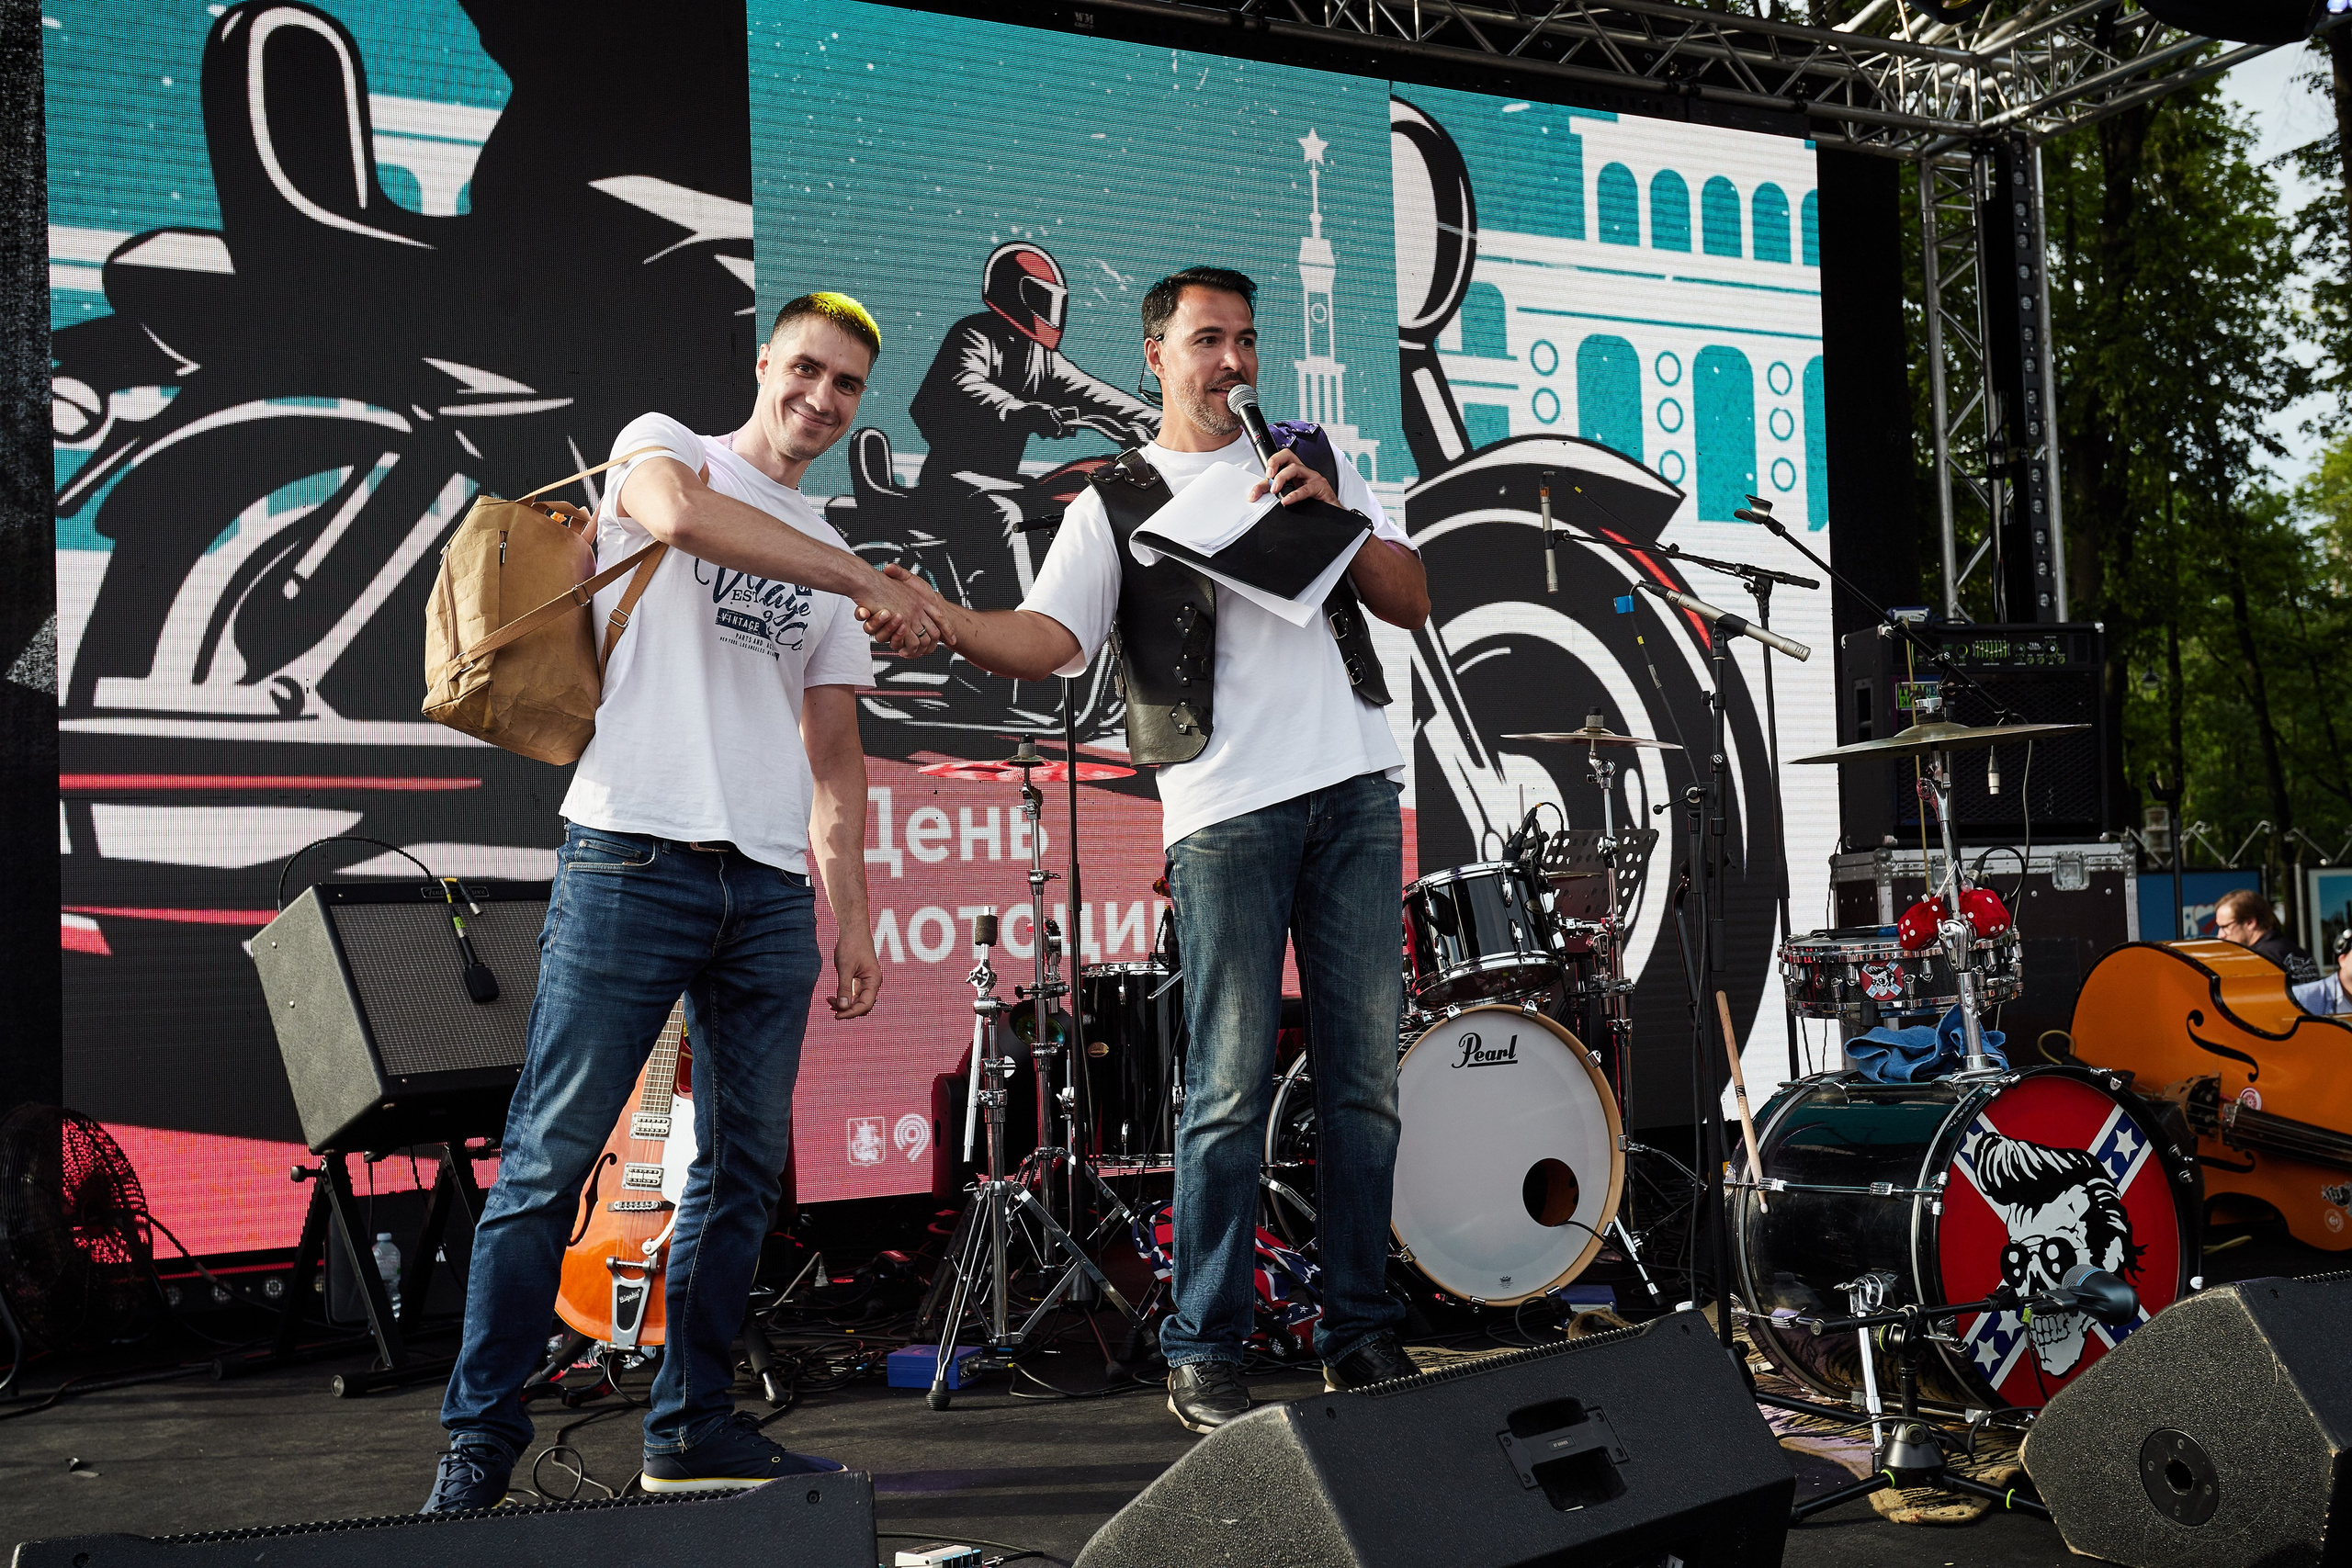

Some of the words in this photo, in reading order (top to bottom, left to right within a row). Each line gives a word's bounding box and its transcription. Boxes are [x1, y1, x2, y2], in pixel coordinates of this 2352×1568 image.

[721, 612, 760, 631] VINTAGE
[736, 632, 752, 643] PARTS
[864, 786, 1049, 878] День
[1452, 1032, 1518, 1068] Pearl
